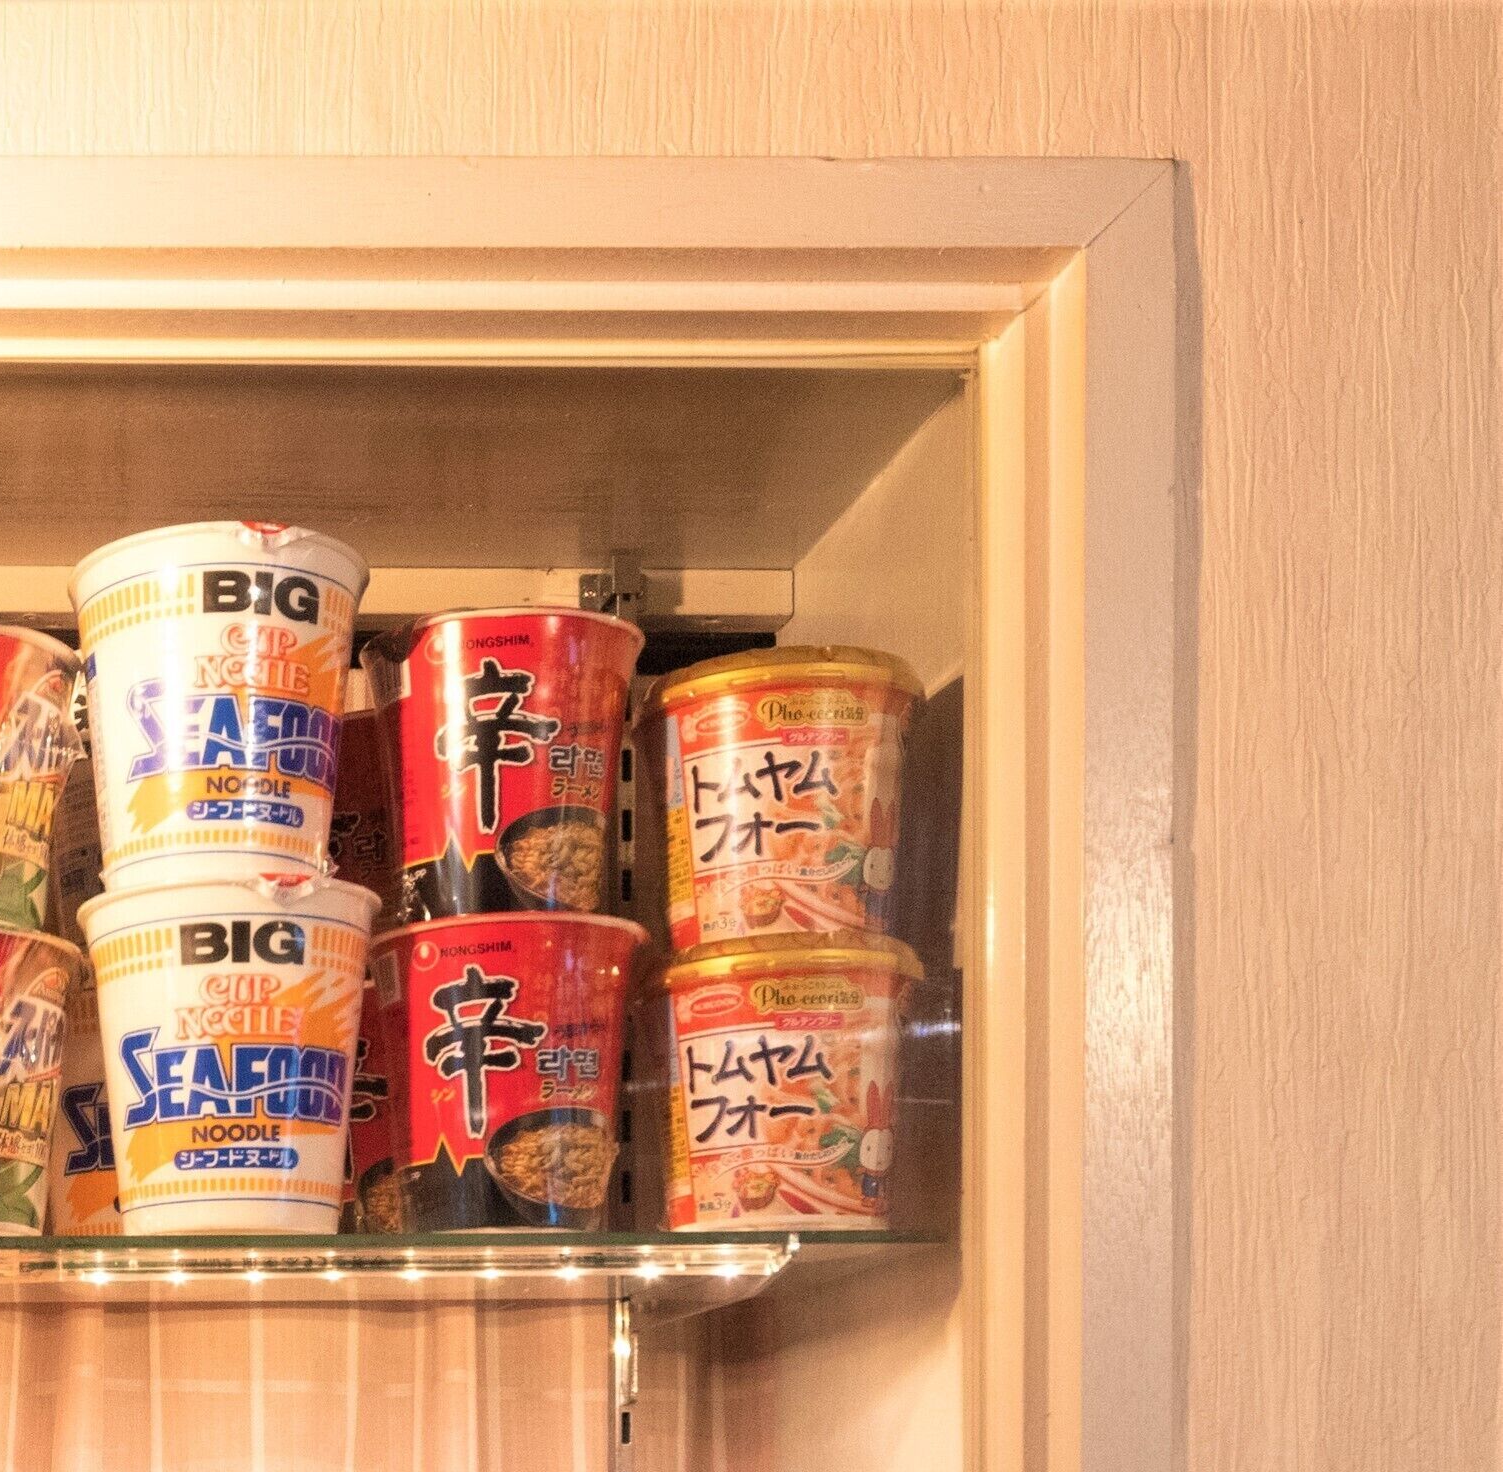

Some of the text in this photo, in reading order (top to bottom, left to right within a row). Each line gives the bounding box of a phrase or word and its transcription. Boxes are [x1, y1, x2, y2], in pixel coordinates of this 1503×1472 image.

[202, 570, 320, 625] BIG
[453, 634, 533, 652] ONGSHIM
[433, 656, 561, 834] 辛
[206, 775, 291, 799] NOODLE
[691, 750, 839, 814] トムヤム
[694, 811, 822, 863] フォー
[179, 920, 306, 966] BIG
[199, 972, 282, 1006] CUP
[423, 963, 548, 1139] 辛
[536, 1045, 600, 1081] 라면
[686, 1034, 833, 1094] トムヤム
[119, 1027, 349, 1132] SEAFOOD
[191, 1124, 281, 1143] NOODLE
[689, 1094, 815, 1144] フォー
[178, 1147, 296, 1169] シーフードヌードル
